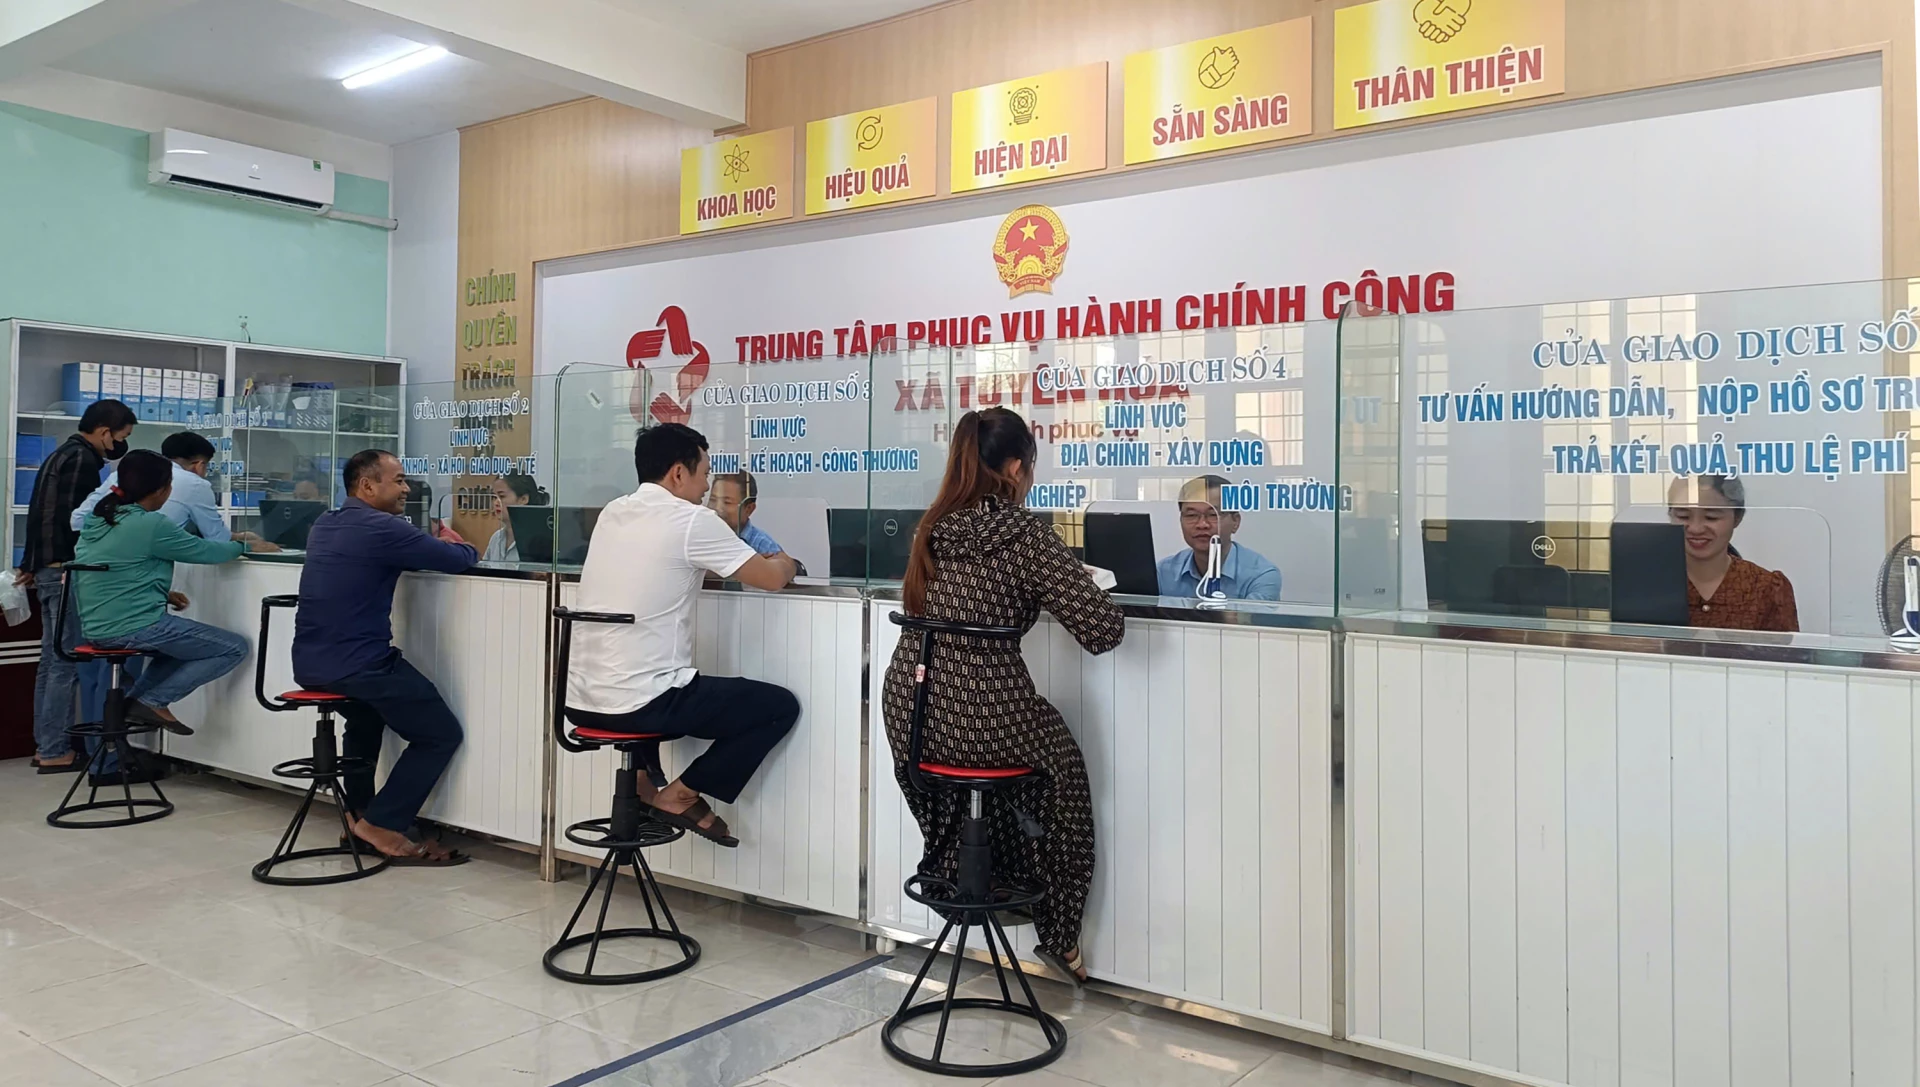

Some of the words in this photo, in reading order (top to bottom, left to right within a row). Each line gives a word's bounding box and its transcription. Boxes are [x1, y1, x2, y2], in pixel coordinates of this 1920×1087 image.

[1354, 65, 1435, 110] THÂN
[1445, 46, 1542, 93] THIỆN
[1152, 104, 1204, 146] SẴN
[1214, 95, 1288, 135] SÀNG
[974, 141, 1023, 178] HIỆN
[1030, 135, 1067, 169] ĐẠI
[825, 167, 866, 202] HIỆU
[872, 154, 909, 195] QUẢ
[697, 192, 738, 221] KHOA
[743, 186, 776, 217] HỌC
[464, 269, 516, 306] CHÍNH
[463, 309, 517, 351] QUYỀN
[735, 329, 824, 364] TRUNG
[834, 320, 897, 357] TÂM
[907, 315, 991, 357] PHỤC
[1000, 309, 1045, 351] VỤ
[1057, 296, 1162, 340] HÀNH
[1176, 281, 1306, 330] CHÍNH
[1322, 269, 1455, 320] CÔNG
[1533, 328, 1607, 368] CỬA
[1623, 332, 1720, 363] GIAO
[1737, 323, 1846, 366] DỊCH
[1859, 306, 1919, 353] SỐ
[1037, 358, 1085, 391] CỬA
[1093, 362, 1154, 388] GIAO
[1159, 358, 1226, 391] DỊCH
[1232, 346, 1268, 380] SỐ
[1272, 355, 1287, 380] 4
[413, 396, 437, 419] CỬA
[440, 400, 468, 418] GIAO
[469, 398, 501, 421] DỊCH
[503, 390, 521, 415] SỐ
[521, 397, 530, 415] 2
[703, 379, 736, 405] CỬA
[740, 383, 781, 404] GIAO
[786, 381, 829, 407] DỊCH
[835, 372, 859, 400] SỐ
[862, 381, 874, 400] 3
[894, 370, 946, 411] XÃ
[1418, 392, 1451, 423] TƯ
[1455, 382, 1503, 422] VẤN
[1512, 383, 1600, 420] HƯỚNG
[1609, 375, 1674, 419] DẪN,
[1698, 378, 1760, 422] NỘP
[1769, 370, 1811, 413] HỒ
[1822, 375, 1865, 412] SƠ
[750, 415, 778, 439] LĨNH
[782, 415, 807, 442] VỰC
[1105, 401, 1145, 429] LĨNH
[1151, 402, 1187, 433] VỰC
[450, 426, 469, 446] LĨNH
[471, 427, 489, 450] VỰC
[1061, 442, 1089, 472] ĐỊA
[1096, 438, 1150, 467] CHÍNH
[1167, 437, 1203, 466] XÂY
[1209, 438, 1264, 472] DỰNG
[1552, 435, 1603, 474] TRẢ
[1611, 434, 1661, 474] KẾT
[1804, 434, 1840, 481] LỆ
[1852, 432, 1908, 473] PHÍ
[437, 454, 449, 475] XÃ
[451, 453, 465, 478] HỘI
[470, 454, 490, 475] GIÁO
[525, 452, 537, 475] TẾ
[709, 449, 739, 474] HÍNH
[751, 447, 766, 473] KẾ
[770, 453, 812, 478] HOẠCH
[822, 448, 858, 472] CÔNG
[862, 449, 919, 472] THƯƠNG
[1025, 480, 1087, 514] NGHIỆP
[1221, 480, 1259, 511] MÔI
[1266, 477, 1353, 512] TRƯỜNG
